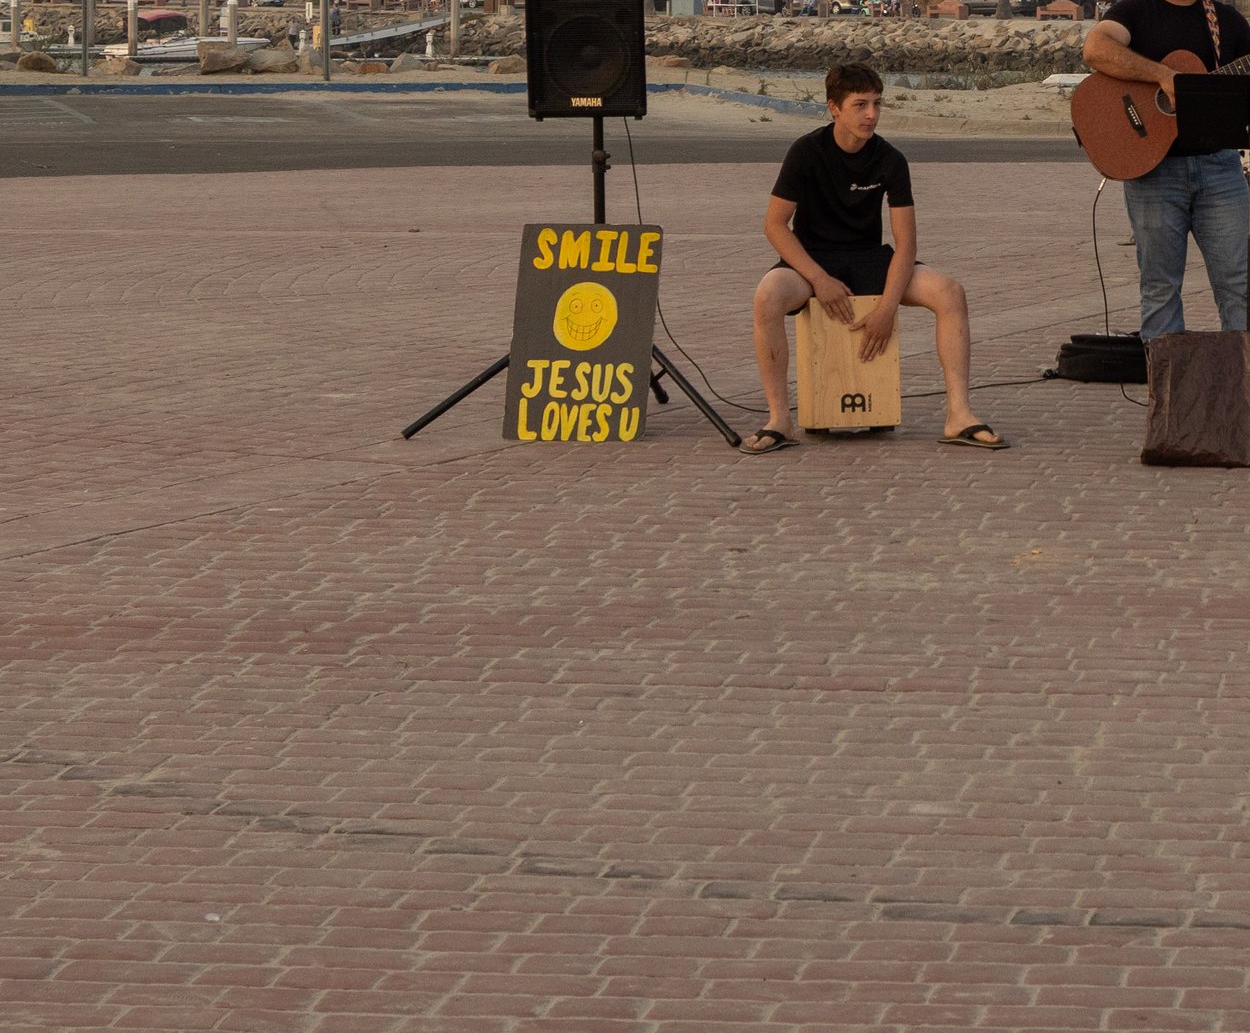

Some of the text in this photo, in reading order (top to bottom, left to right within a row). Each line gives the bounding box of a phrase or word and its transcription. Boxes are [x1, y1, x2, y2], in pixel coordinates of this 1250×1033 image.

[570, 97, 603, 107] YAMAHA
[533, 228, 660, 273] SMILE
[521, 359, 634, 404] JESUS
[517, 397, 640, 442] LOVES U
